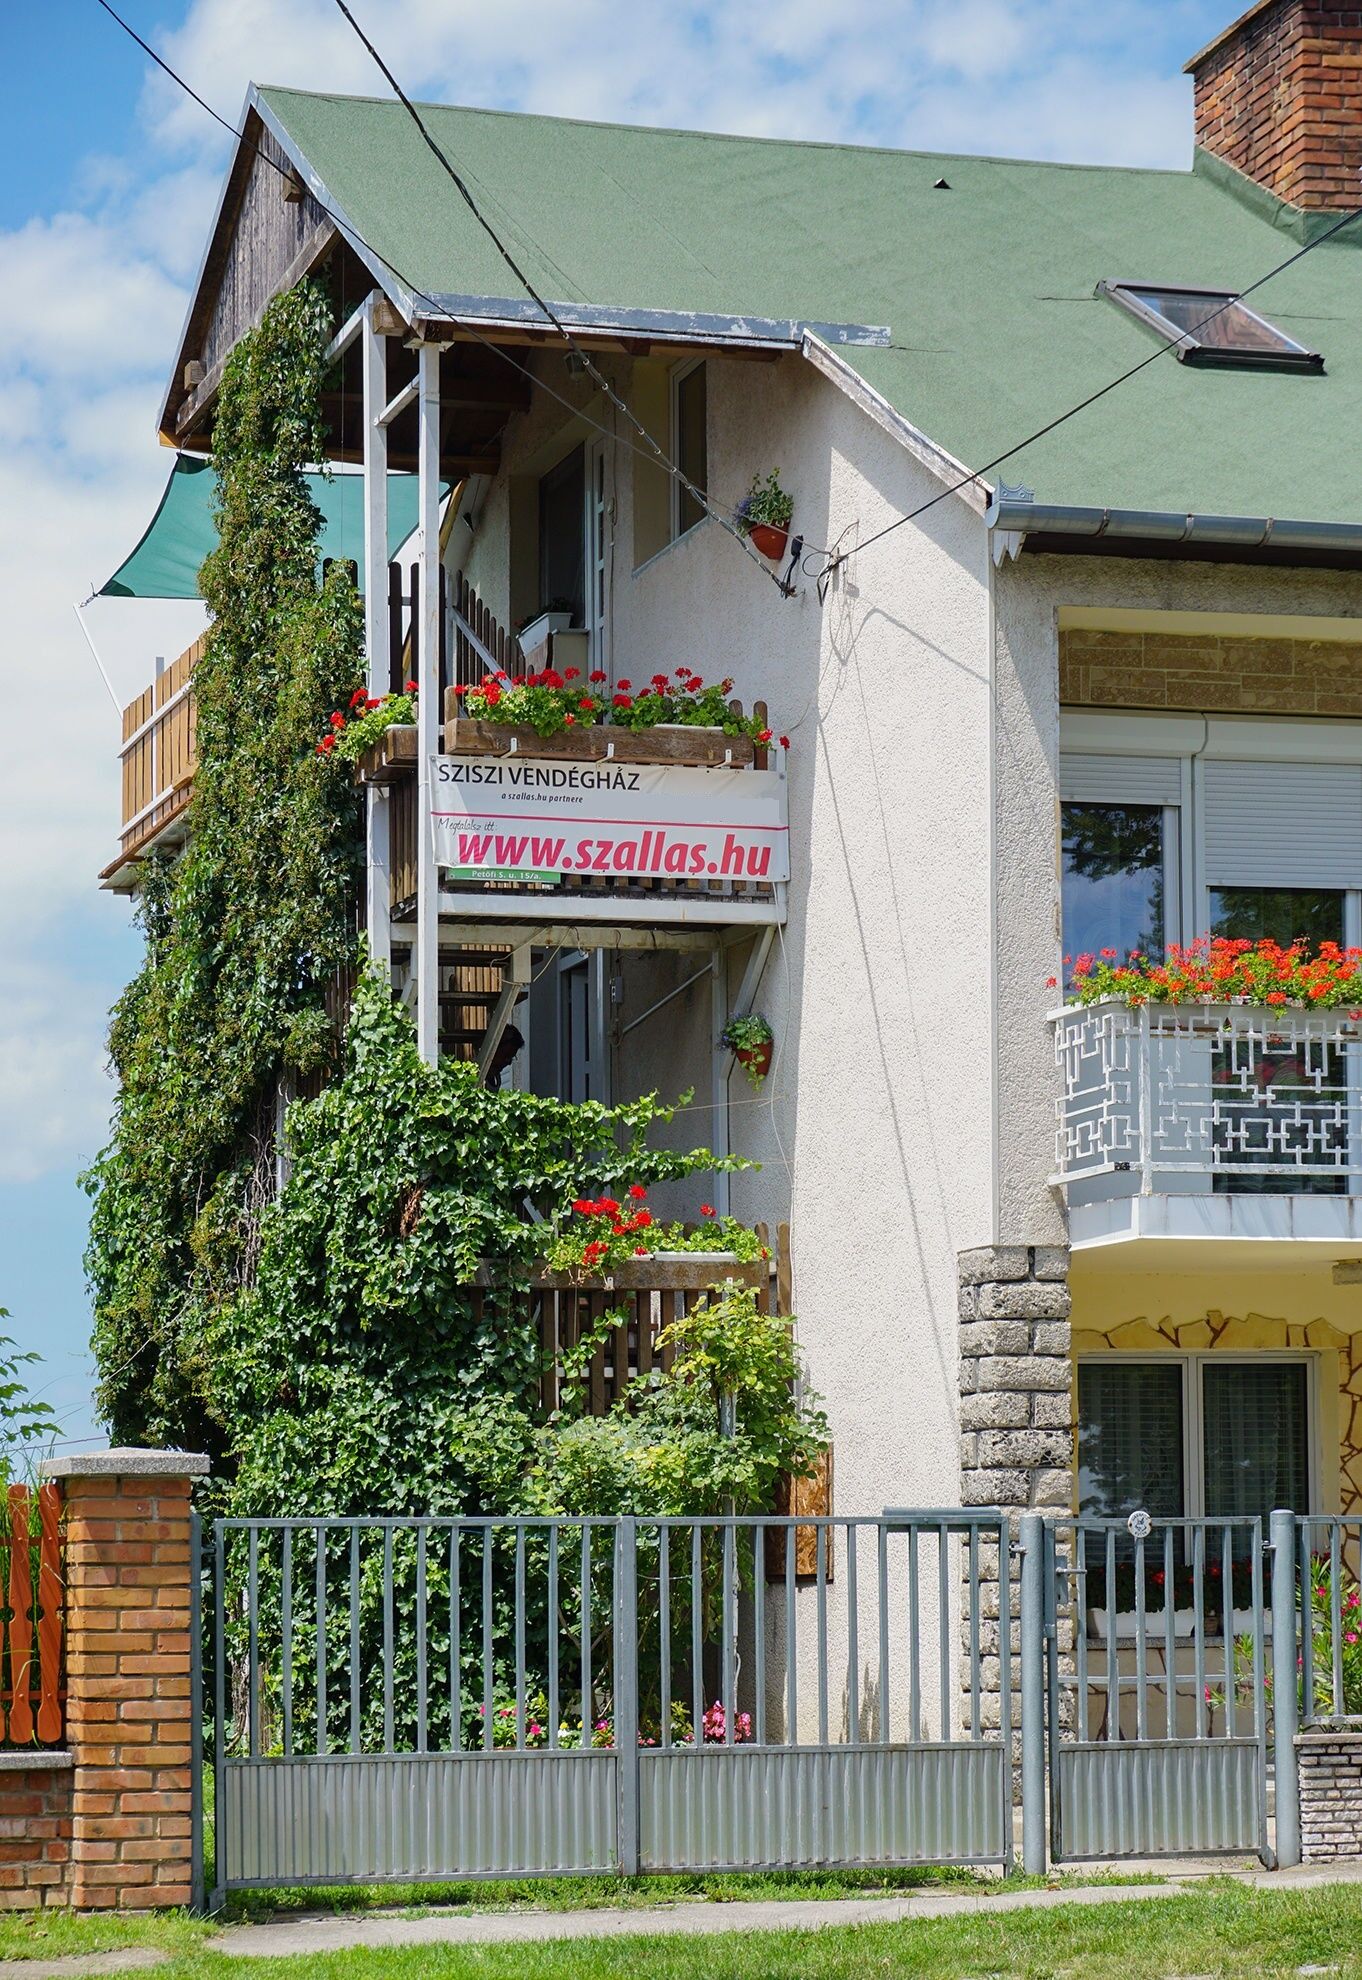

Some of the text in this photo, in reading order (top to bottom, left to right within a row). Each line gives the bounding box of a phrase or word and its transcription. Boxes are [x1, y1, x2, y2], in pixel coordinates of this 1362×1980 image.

[439, 764, 641, 791] SZISZI VENDÉGHÁZ
[508, 792, 547, 801] szallas.hu
[548, 795, 584, 804] partnere
[458, 830, 771, 876] www.szallas.hu
